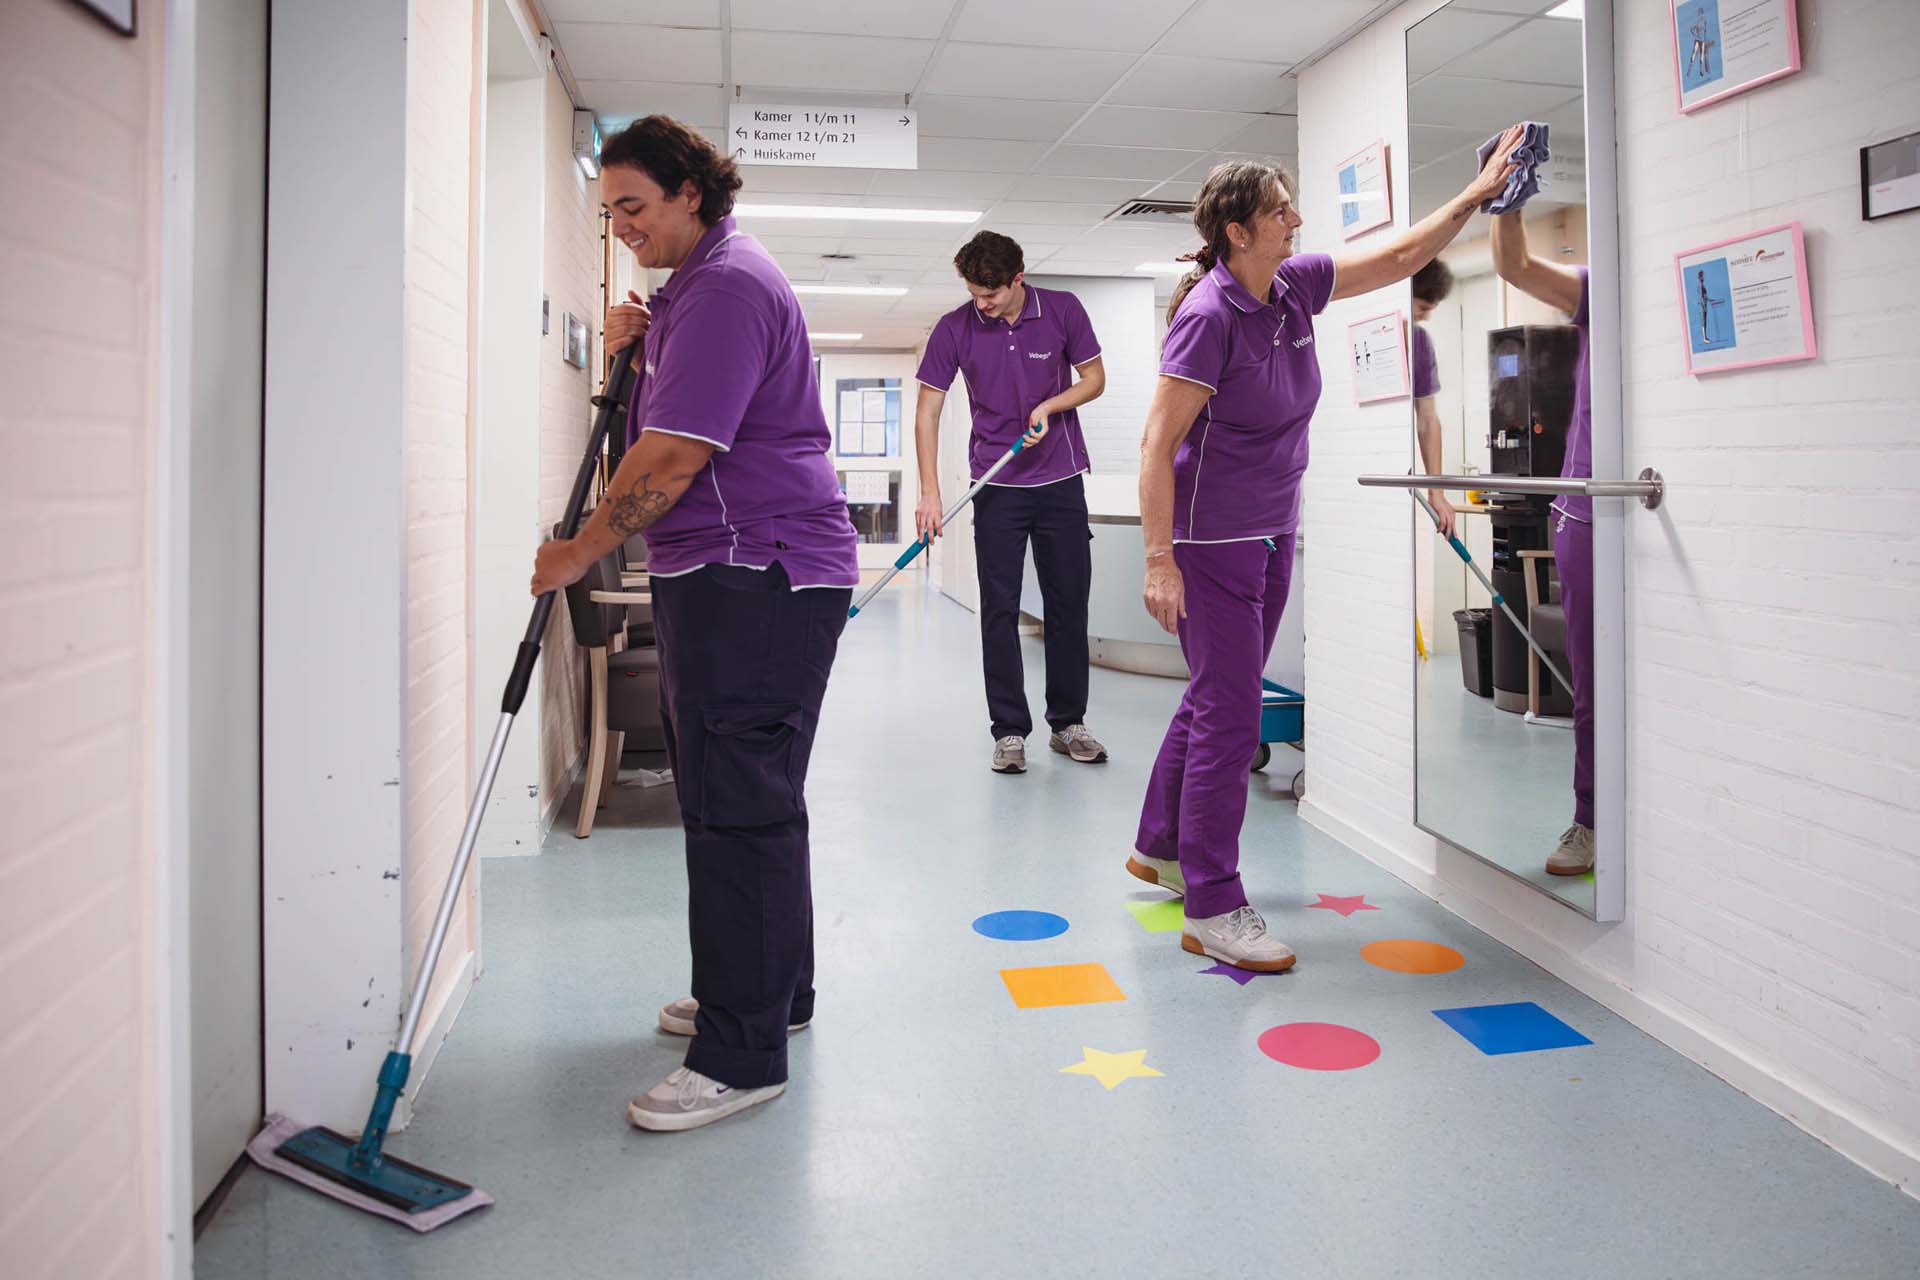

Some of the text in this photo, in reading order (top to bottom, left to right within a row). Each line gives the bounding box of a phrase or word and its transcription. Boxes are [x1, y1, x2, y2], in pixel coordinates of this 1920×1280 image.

[754, 110, 856, 126] Kamer 1 t/m 11
[754, 130, 856, 144] Kamer 12 t/m 21
[754, 148, 817, 161] Huiskamer
